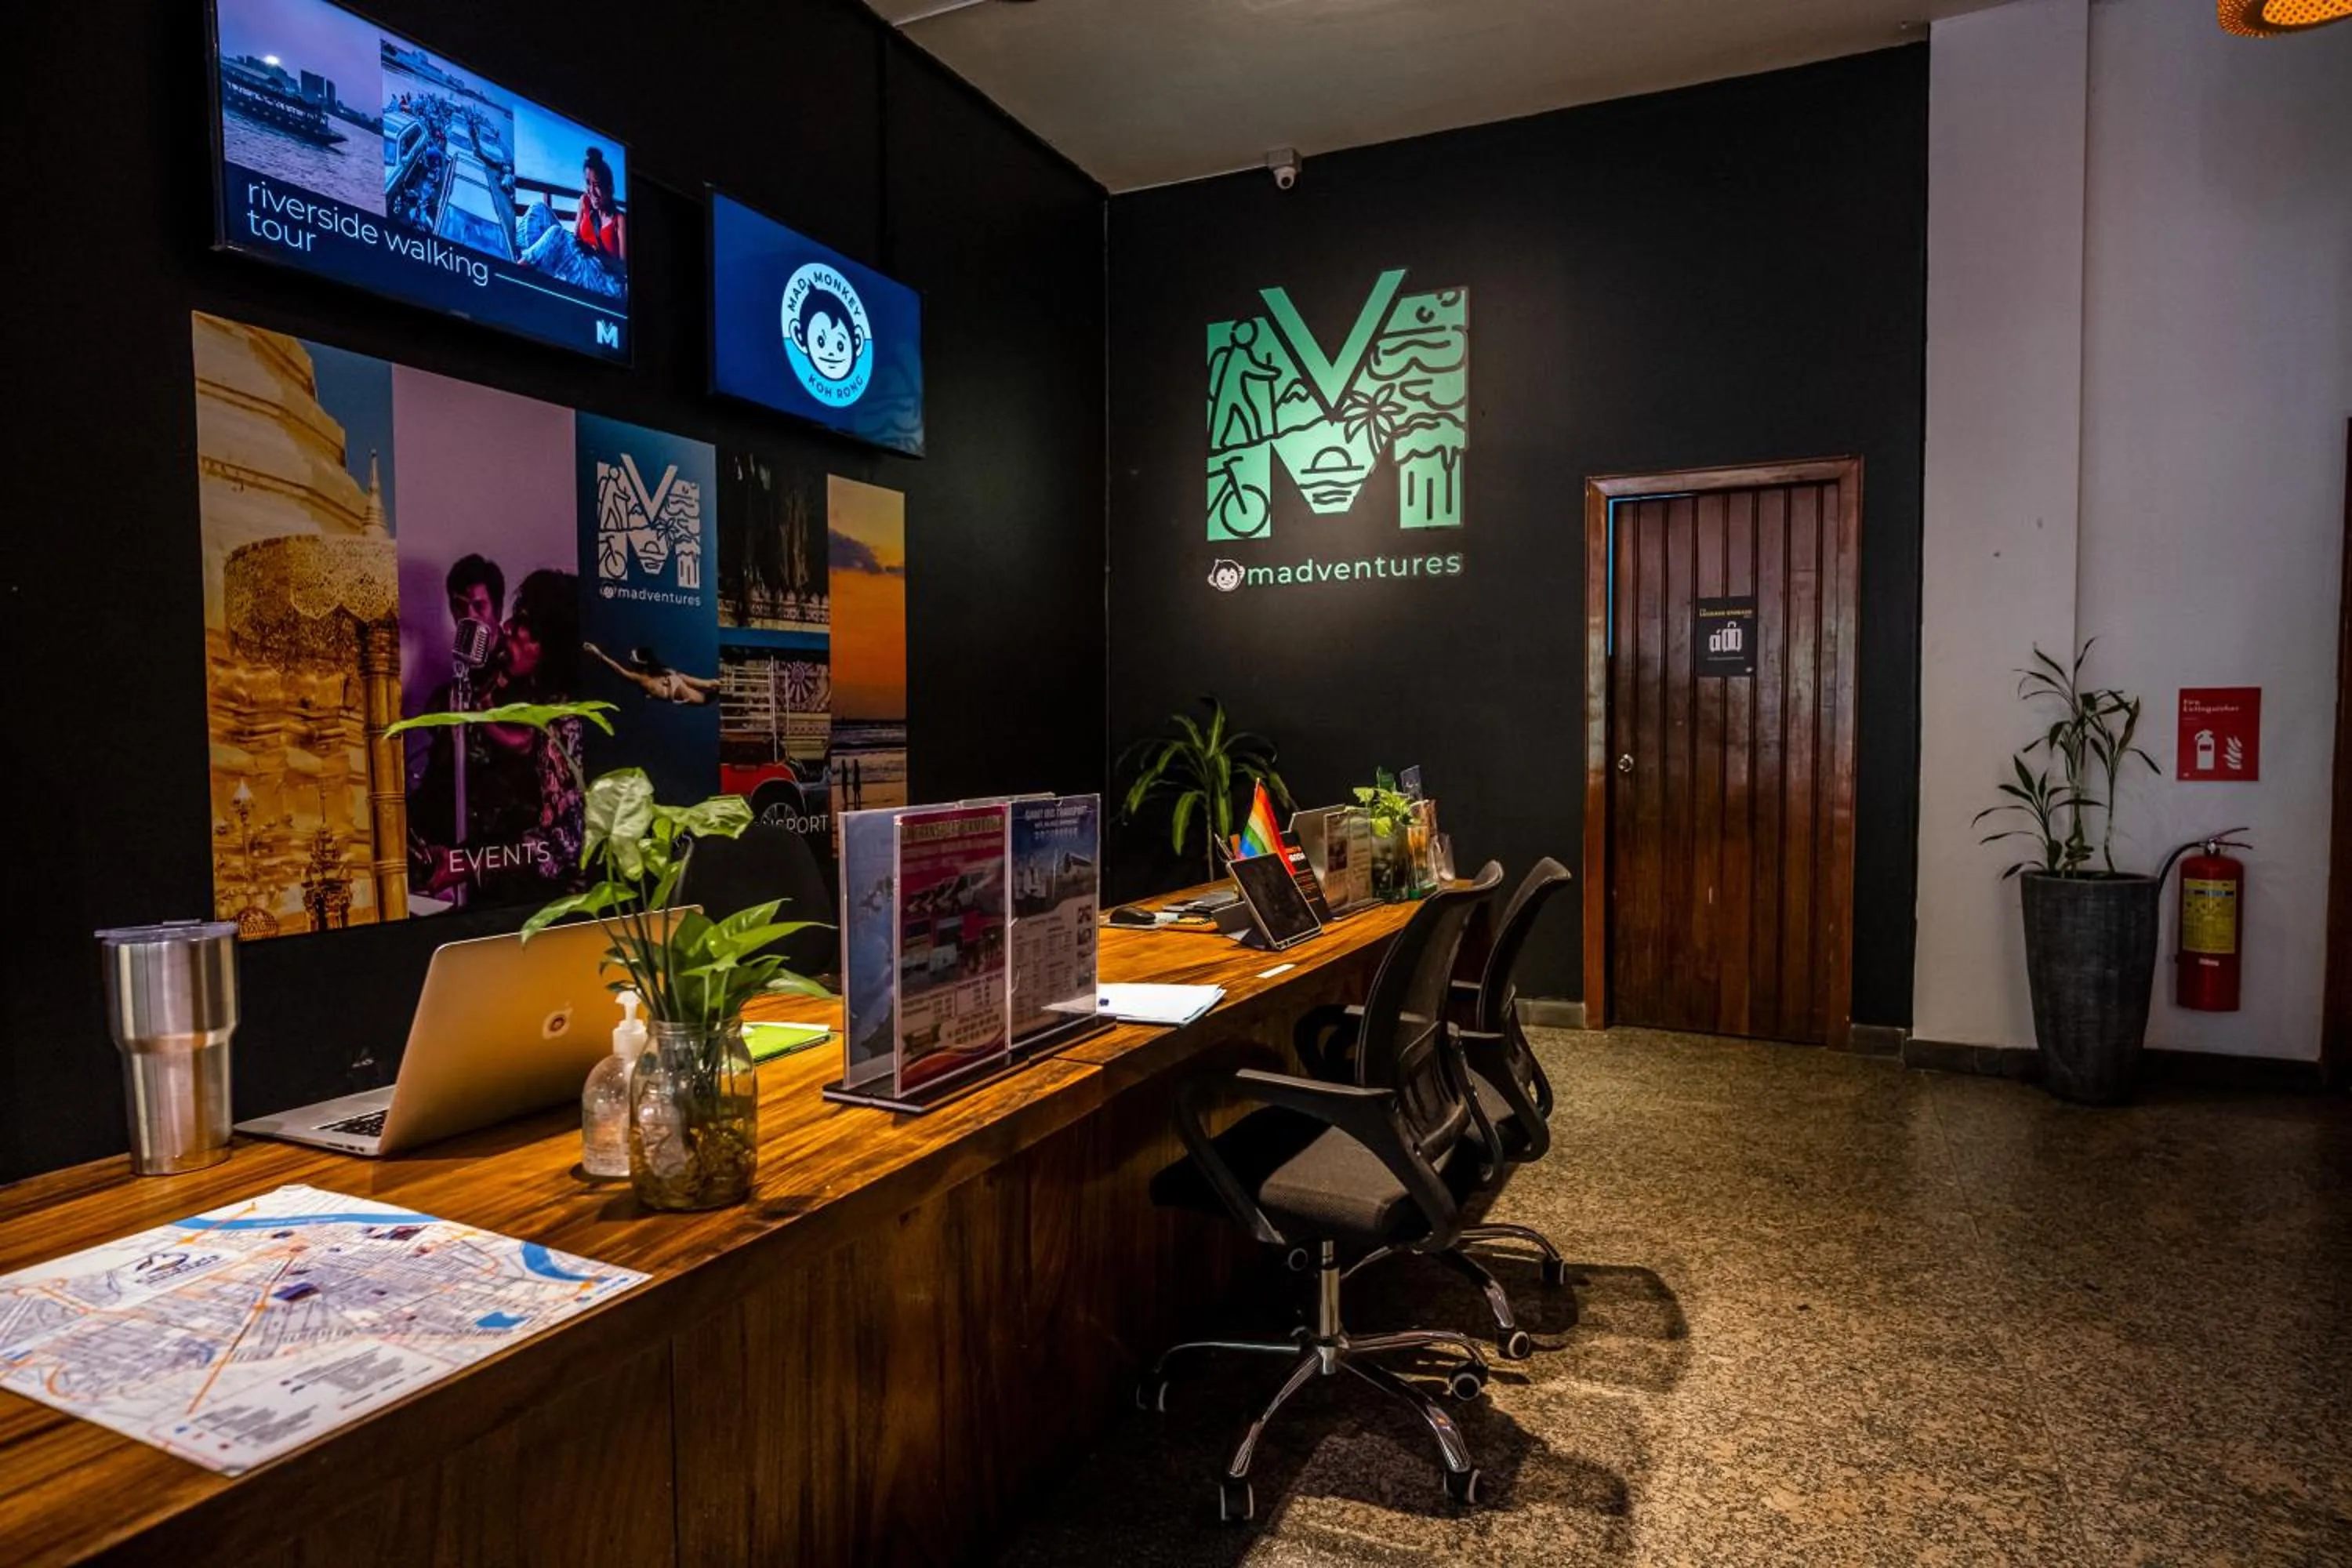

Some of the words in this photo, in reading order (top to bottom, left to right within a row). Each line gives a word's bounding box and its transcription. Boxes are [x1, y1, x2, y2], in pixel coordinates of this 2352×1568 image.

[246, 209, 316, 252] tour
[247, 180, 379, 245] riverside
[384, 230, 488, 286] walking
[787, 278, 807, 312] MAD
[814, 271, 862, 316] MONKEY
[808, 374, 832, 398] KOH
[836, 374, 863, 400] RONG
[1247, 553, 1463, 586] madventures
[619, 588, 701, 606] madventures
[449, 842, 550, 873] EVENTS
